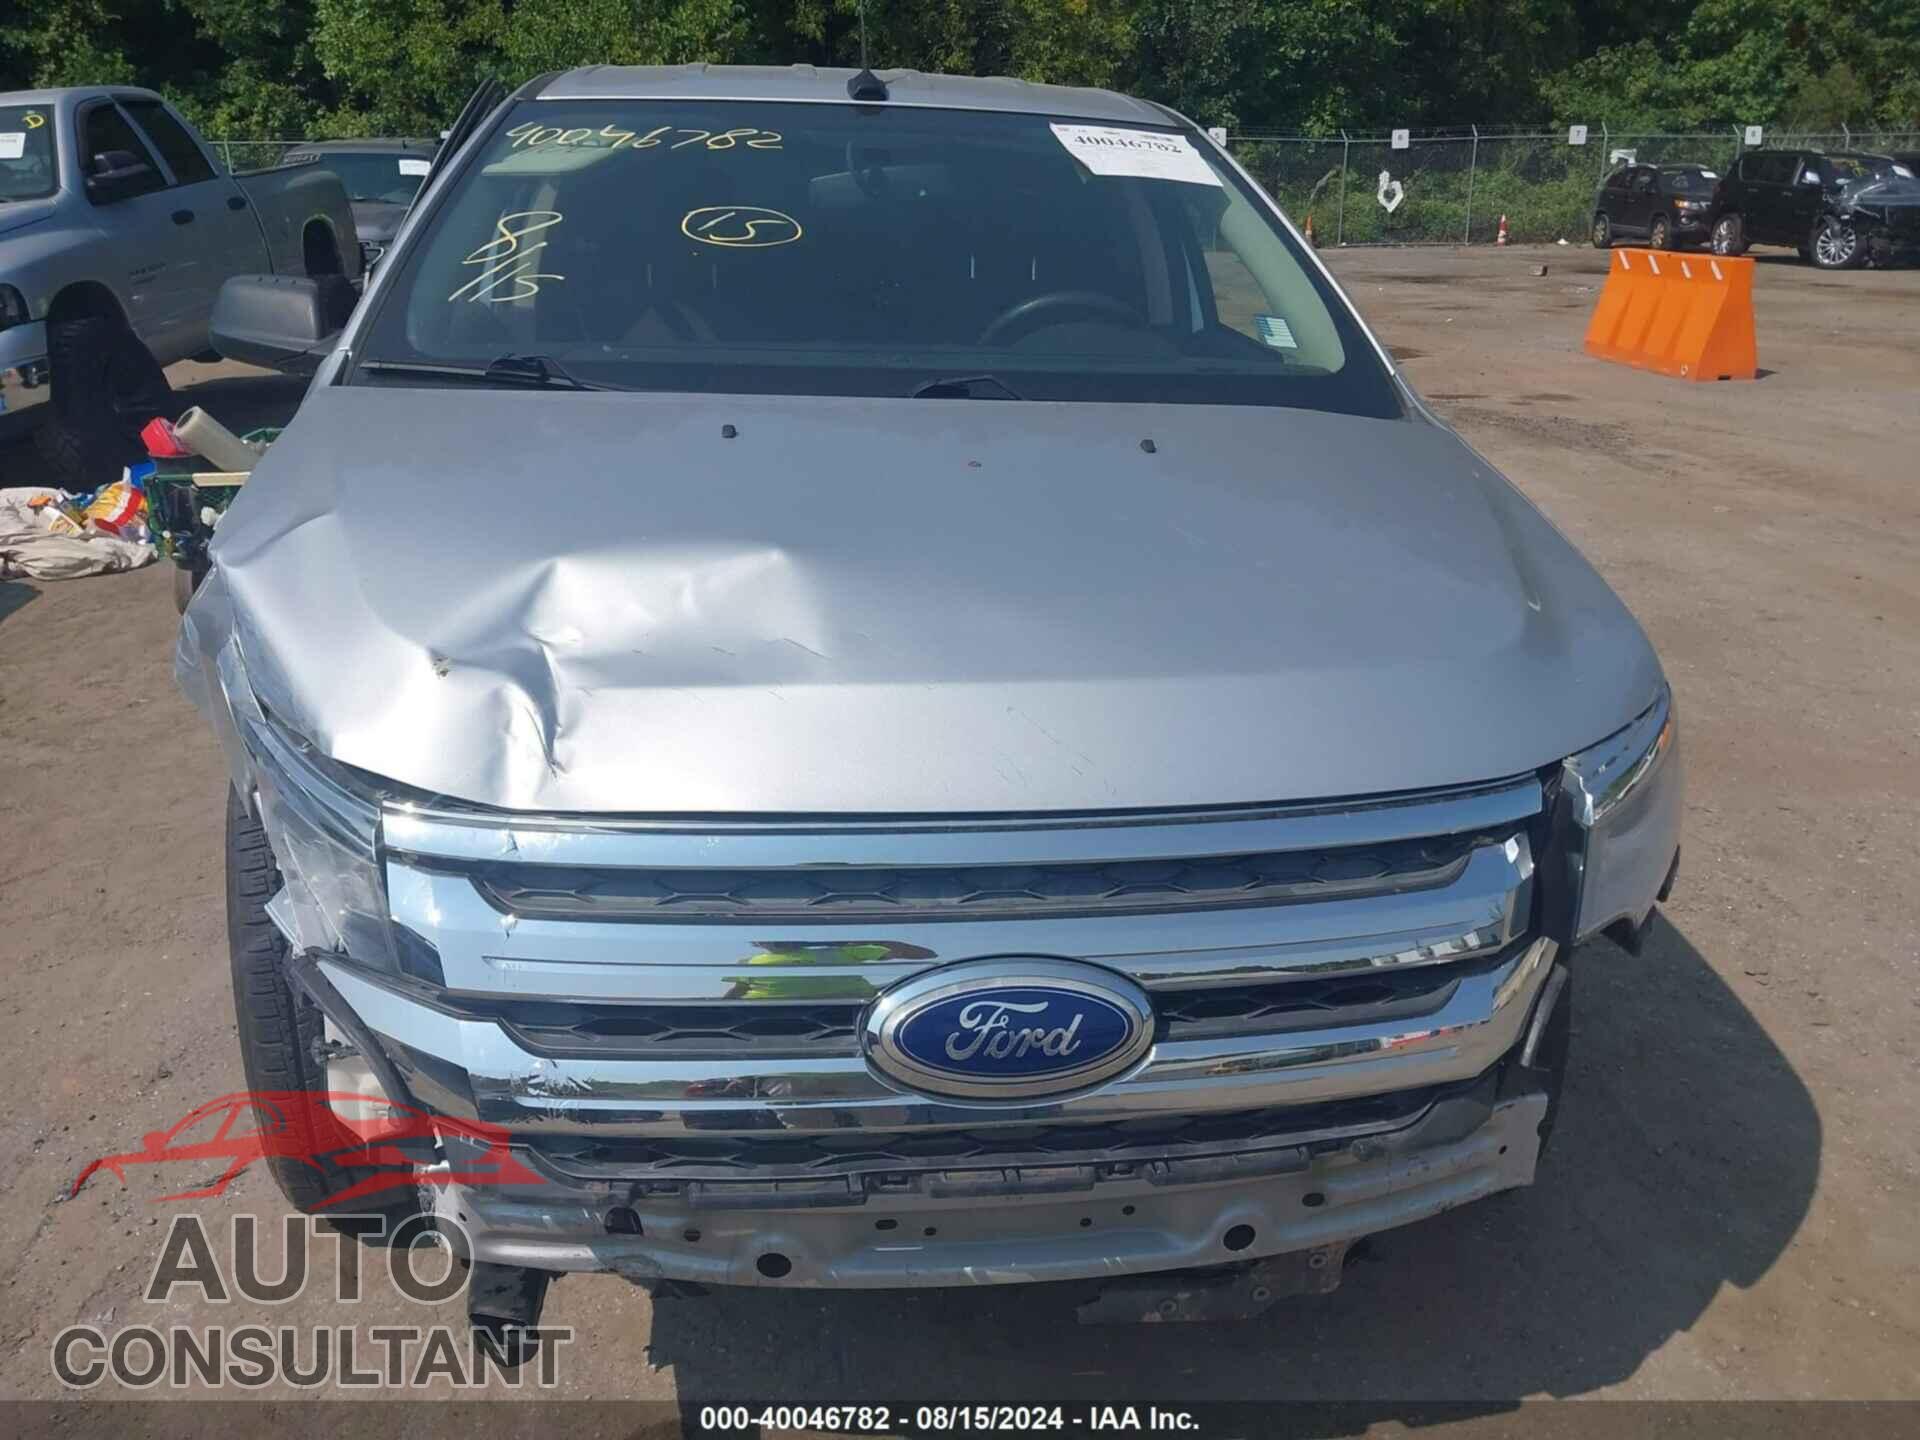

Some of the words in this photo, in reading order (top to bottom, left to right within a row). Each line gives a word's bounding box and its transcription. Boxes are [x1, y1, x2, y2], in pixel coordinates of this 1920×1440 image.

[506, 121, 783, 150] 40046782
[1074, 133, 1183, 154] 40046782
[944, 1000, 1084, 1062] Ford
